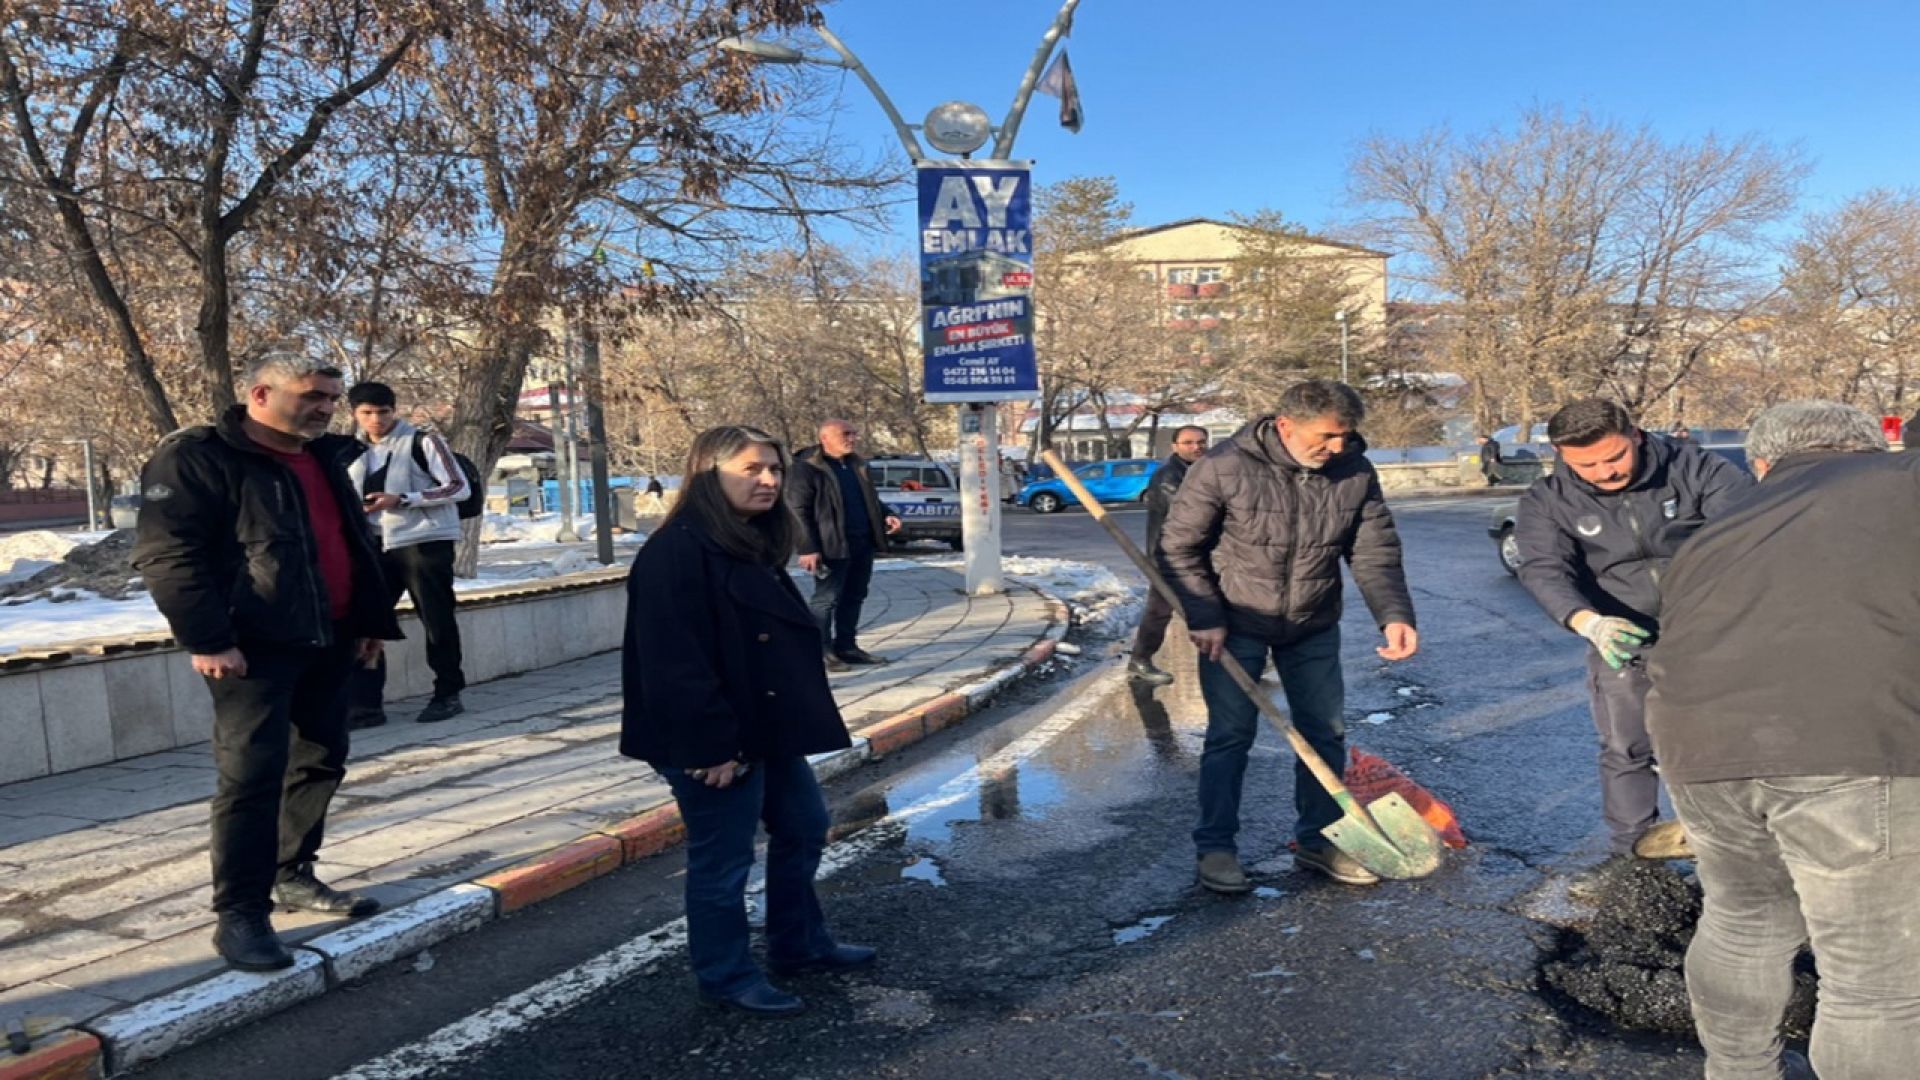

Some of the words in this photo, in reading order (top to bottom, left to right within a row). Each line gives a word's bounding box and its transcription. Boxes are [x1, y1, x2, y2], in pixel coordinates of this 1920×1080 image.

[929, 176, 1020, 228] AY
[923, 230, 1028, 253] EMLAK
[933, 343, 976, 356] EMLAK
